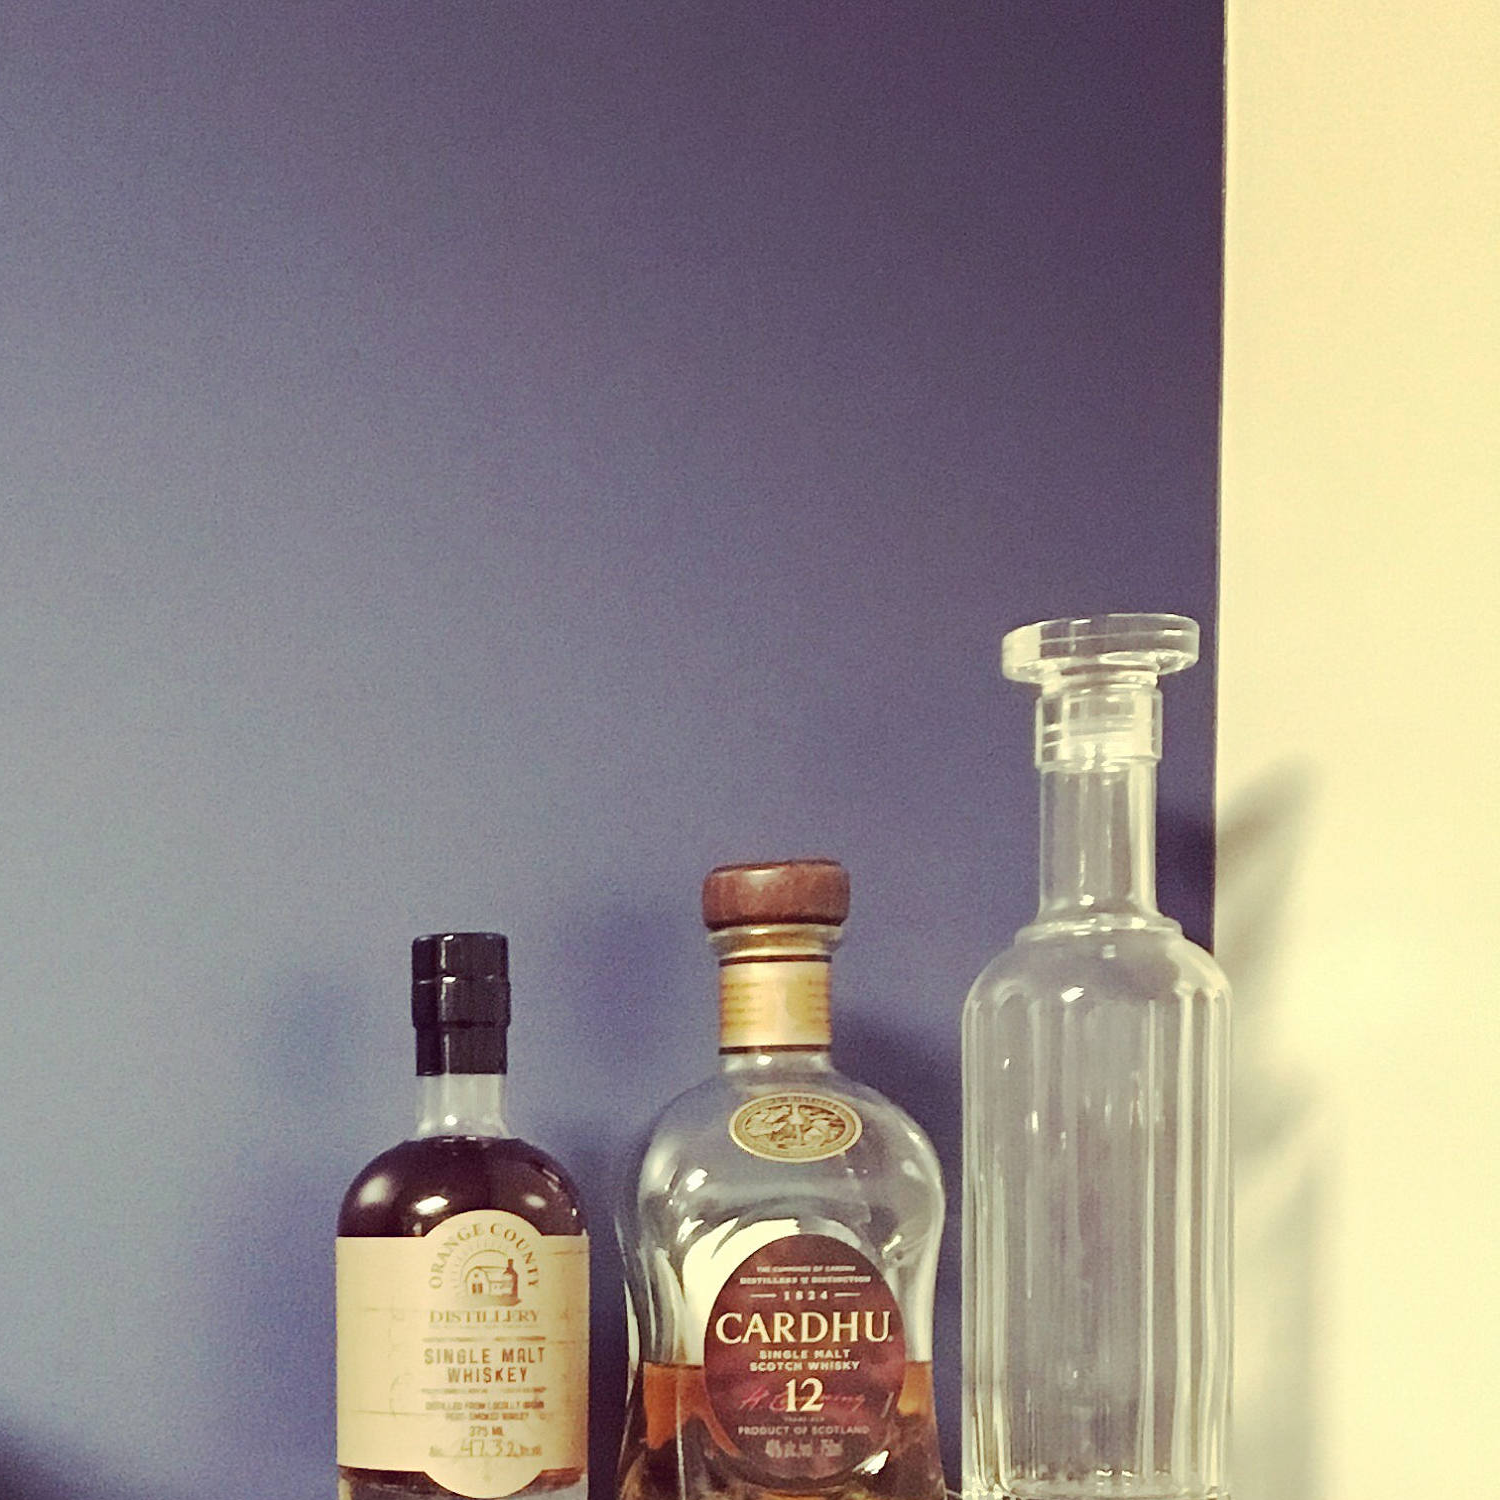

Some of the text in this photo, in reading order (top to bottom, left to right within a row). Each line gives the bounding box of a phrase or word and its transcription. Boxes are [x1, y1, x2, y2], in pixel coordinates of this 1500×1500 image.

[428, 1222, 539, 1290] ORANGE COUNTY
[783, 1290, 829, 1301] 1824
[429, 1308, 540, 1323] DISTILLERY
[715, 1310, 891, 1345] CARDHU
[423, 1345, 546, 1365] SINGLE MALT
[759, 1348, 851, 1360] SINGLE MALT
[749, 1360, 861, 1372] SCOTCH WHISKY
[447, 1366, 528, 1384] WHISKEY
[784, 1377, 825, 1413] 12
[737, 1425, 790, 1436] PRODUCT
[811, 1425, 871, 1435] SCOTLAND
